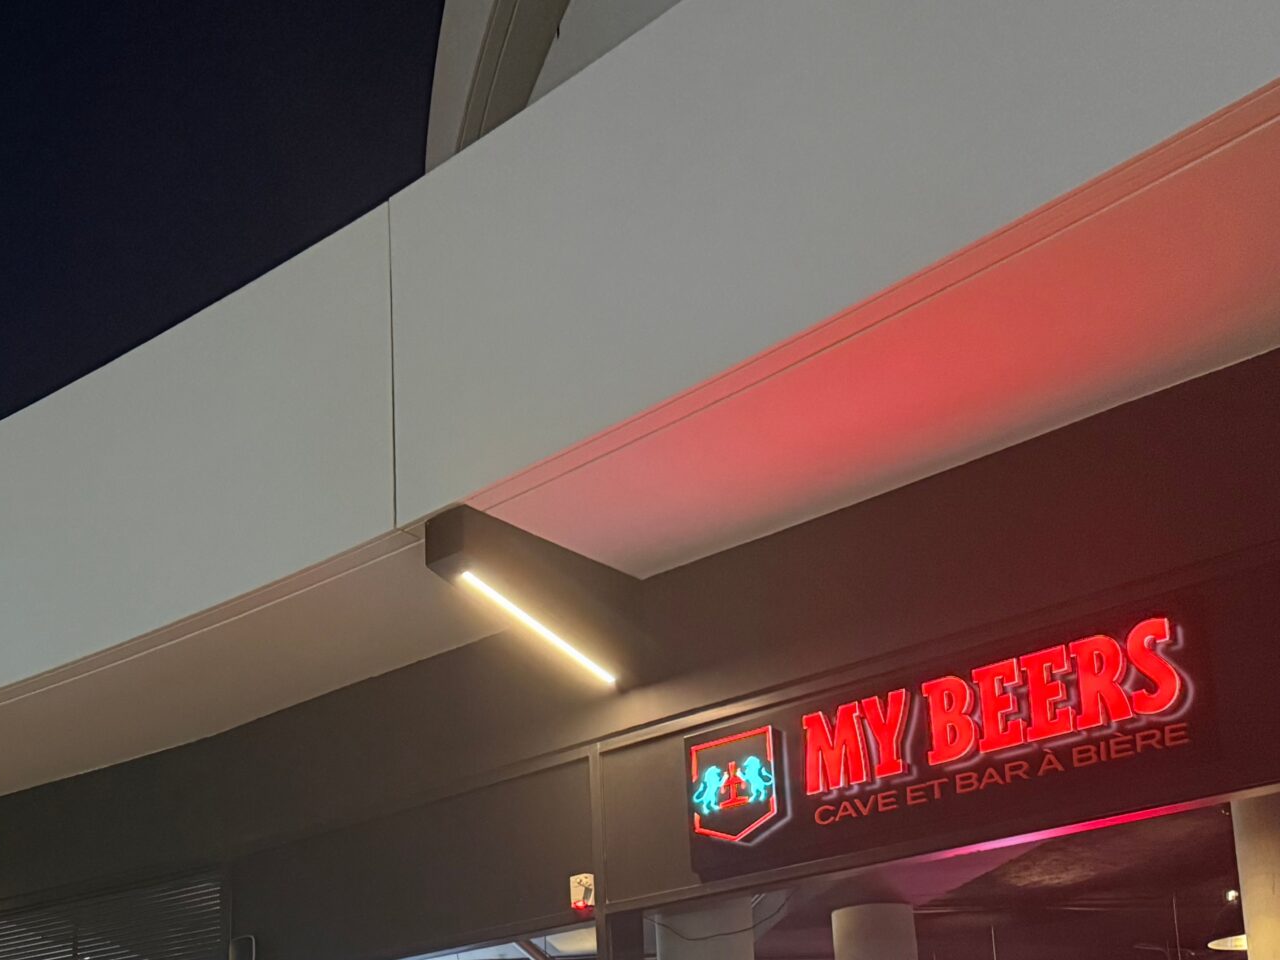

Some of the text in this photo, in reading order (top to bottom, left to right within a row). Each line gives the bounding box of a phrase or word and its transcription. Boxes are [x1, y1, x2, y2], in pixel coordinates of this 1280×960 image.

[803, 617, 1182, 796] MY BEERS
[814, 723, 1191, 825] CAVE ET BAR À BIÈRE
